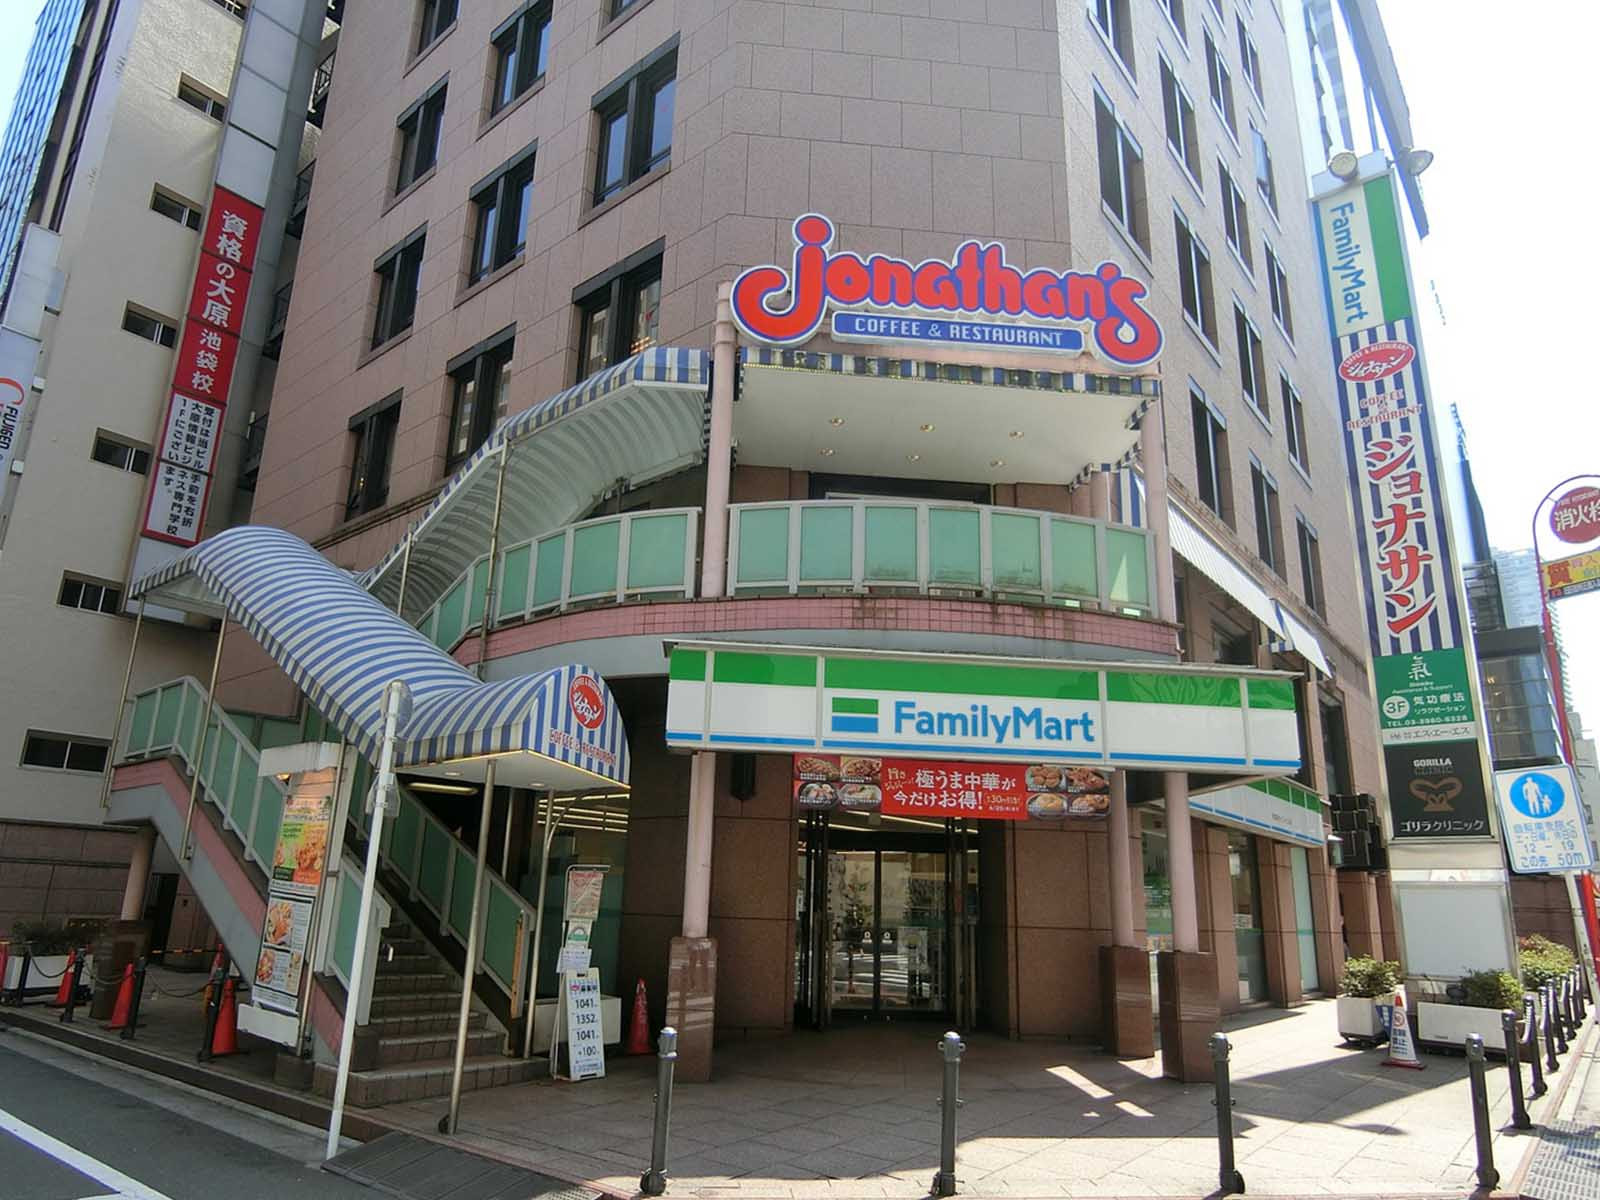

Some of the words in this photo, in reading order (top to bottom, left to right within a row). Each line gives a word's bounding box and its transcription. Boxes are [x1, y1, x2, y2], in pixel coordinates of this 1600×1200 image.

[202, 210, 248, 328] 資格の大原
[1329, 201, 1369, 324] FamilyMart
[854, 317, 921, 336] COFFEE
[928, 323, 942, 336] &
[949, 324, 1065, 347] RESTAURANT
[191, 329, 222, 394] 池袋校
[1359, 388, 1405, 409] COFFEE
[1346, 404, 1424, 431] RESTAURANT
[1364, 434, 1437, 635] ジョナサン
[1385, 700, 1406, 714] 3F
[894, 700, 1096, 745] FamilyMart
[1413, 758, 1453, 767] GORILLA
[915, 768, 1017, 791] 極うま中華が
[893, 789, 984, 811] 今だけお得!
[1400, 820, 1485, 832] ゴリラクリニック
[1524, 843, 1536, 854] 12
[1562, 840, 1575, 851] 19
[1520, 855, 1549, 868] この先
[1558, 852, 1585, 866] 50m
[575, 998, 594, 1009] 1041
[576, 1014, 596, 1025] 1352
[576, 1030, 595, 1041] 1041
